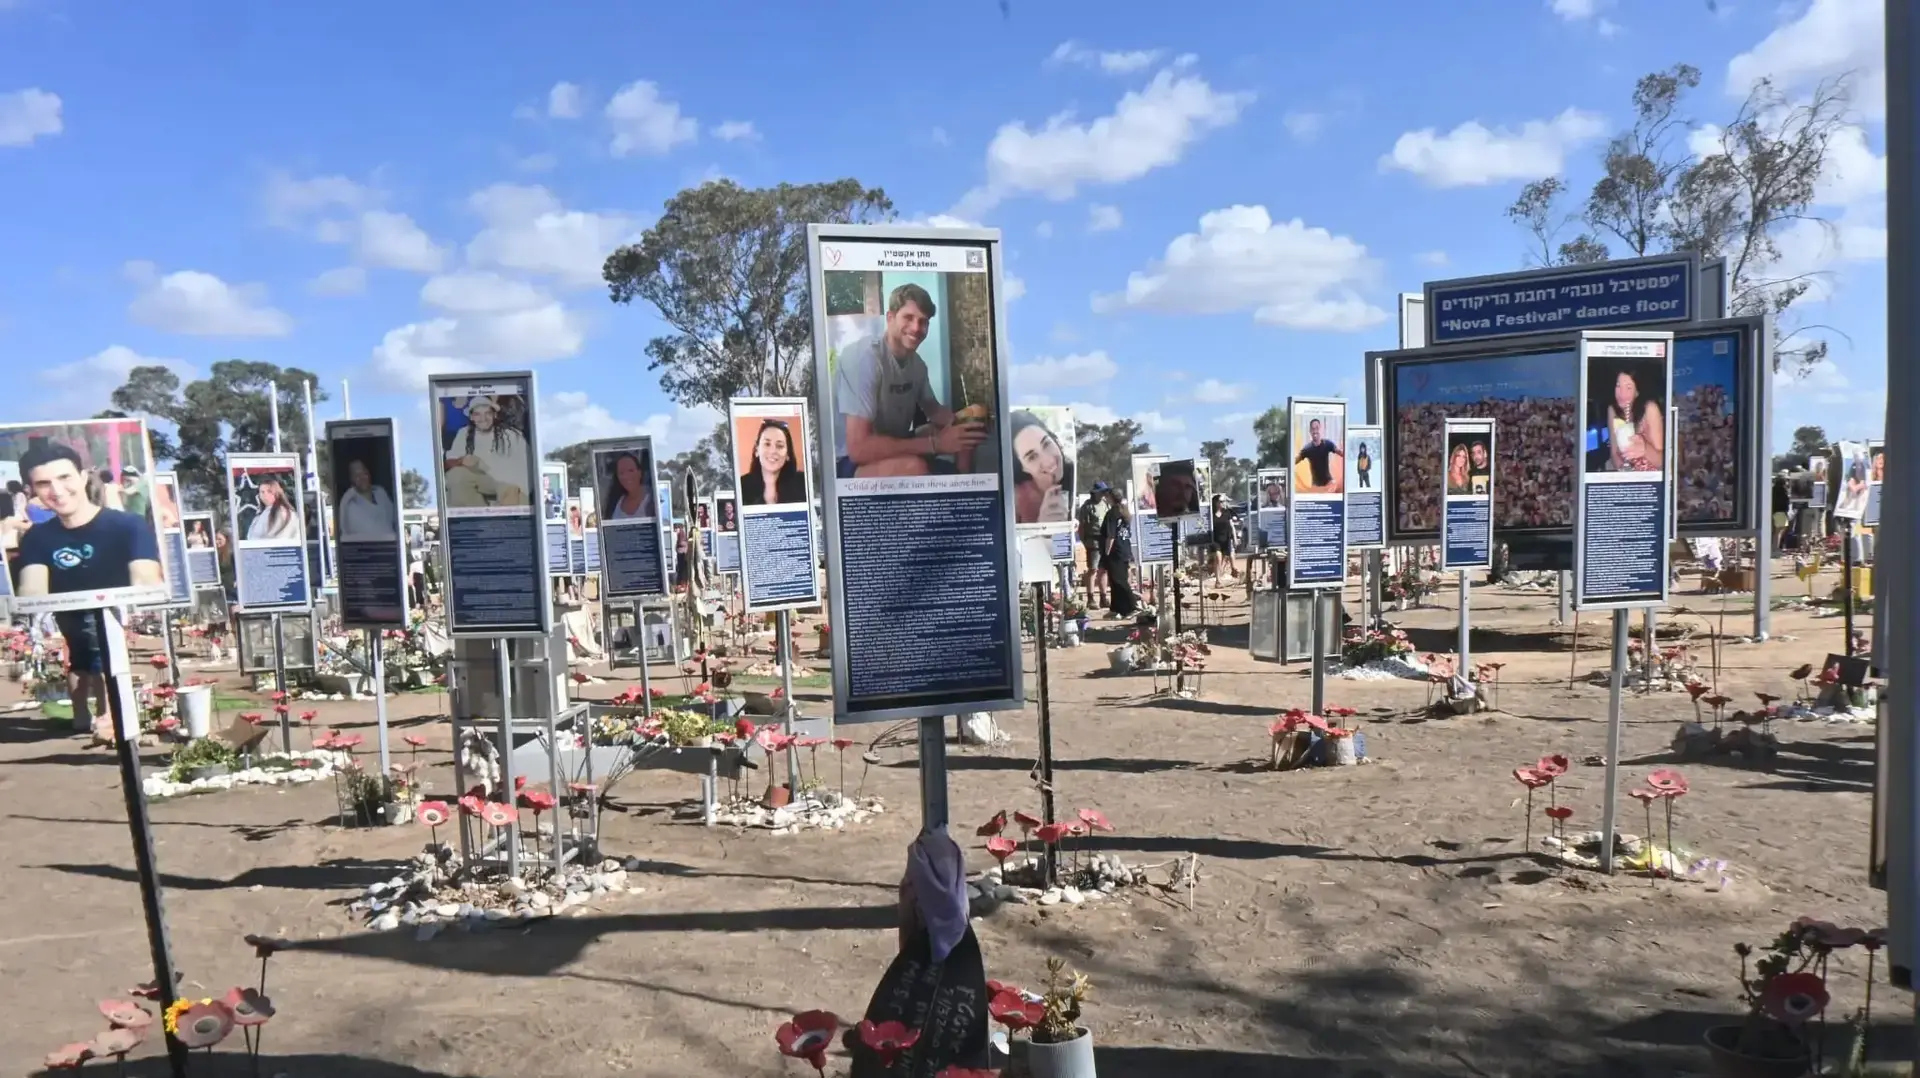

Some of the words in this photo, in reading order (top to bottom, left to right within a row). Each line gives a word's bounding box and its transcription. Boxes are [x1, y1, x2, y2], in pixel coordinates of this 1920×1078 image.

[916, 250, 931, 258] מתן
[877, 259, 904, 267] Matan
[1441, 293, 1510, 311] הריקודים
[1514, 288, 1556, 304] רחבת
[1441, 318, 1491, 331] "Nova
[1495, 307, 1571, 327] Festival"
[1576, 305, 1631, 318] dance
[1636, 300, 1679, 313] floor
[898, 480, 909, 489] the
